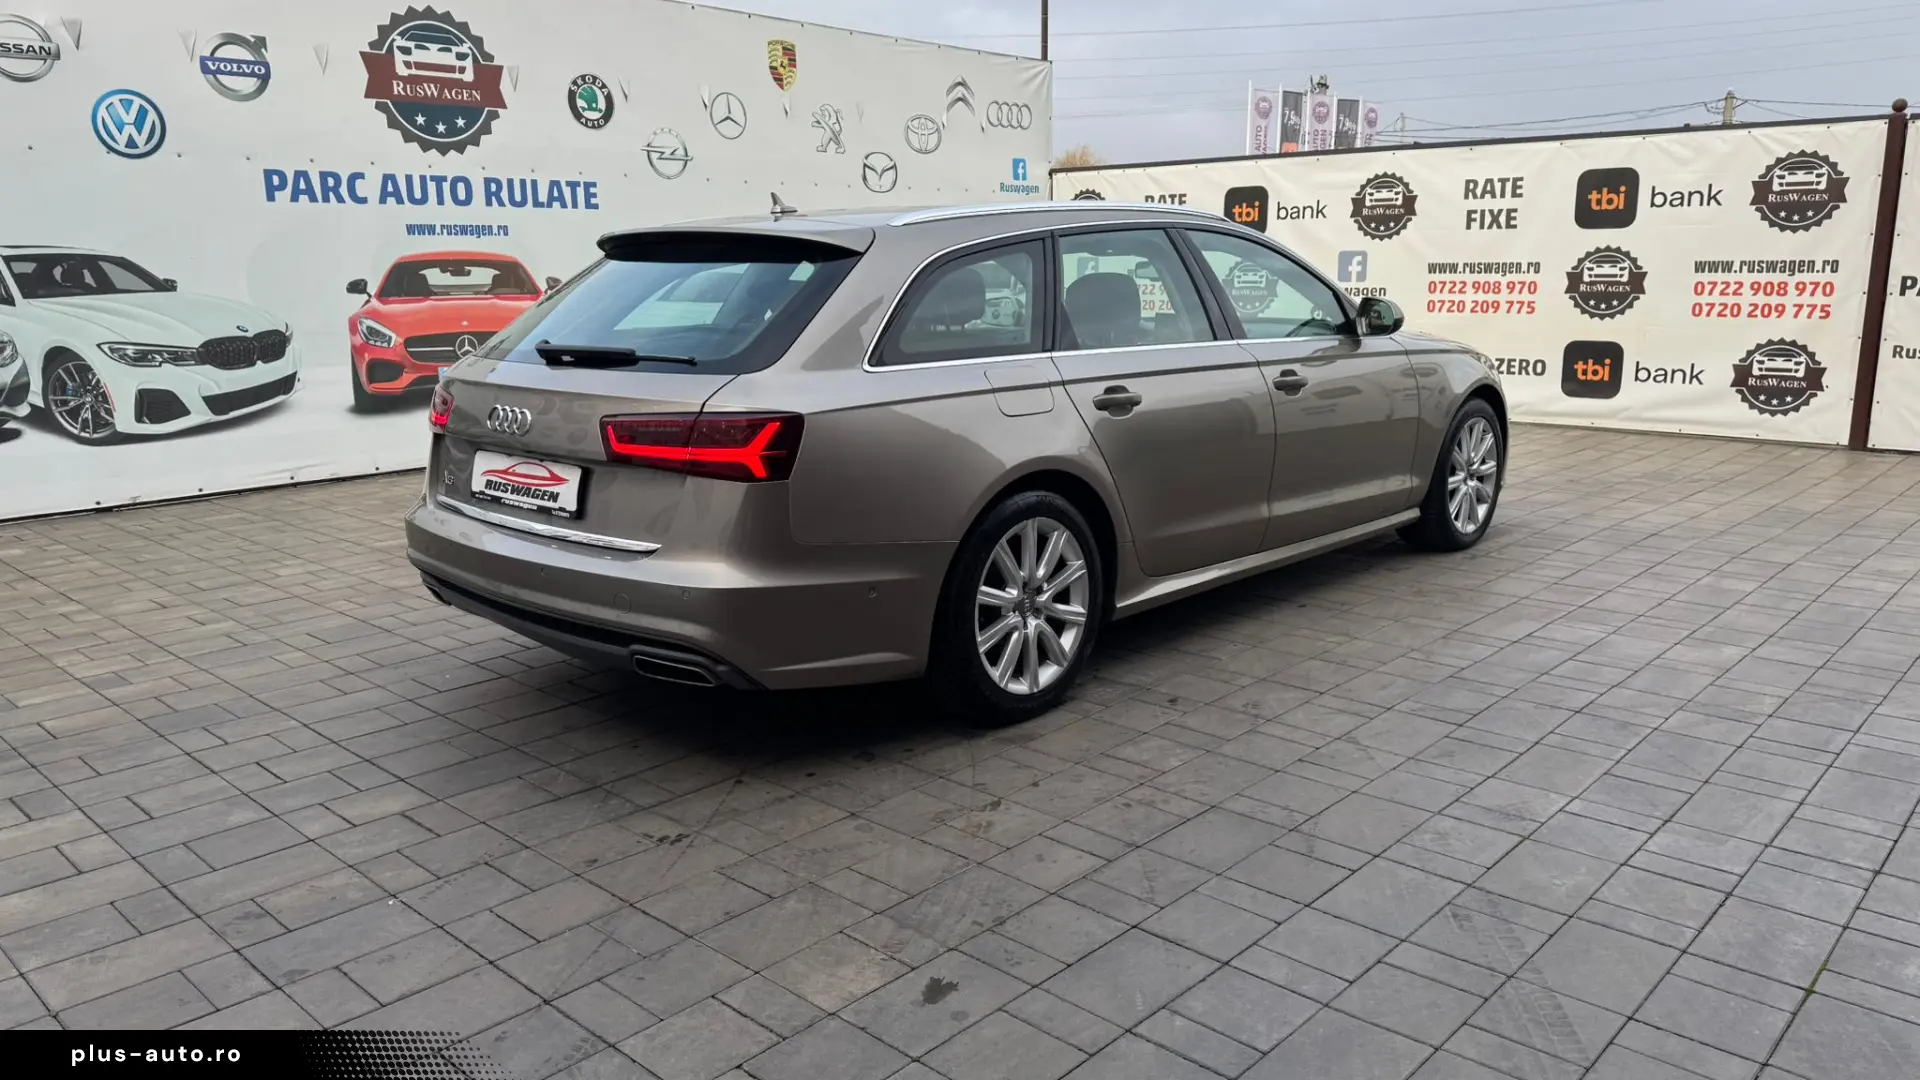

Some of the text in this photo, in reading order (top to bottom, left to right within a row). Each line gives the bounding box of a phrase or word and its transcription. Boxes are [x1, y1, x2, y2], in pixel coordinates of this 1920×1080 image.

[205, 61, 265, 74] VOLVO
[580, 117, 605, 128] AUTO
[263, 169, 599, 210] PARC AUTO RULATE
[1000, 182, 1040, 195] Ruswagen
[1464, 176, 1524, 200] RATE
[1588, 183, 1723, 211] tbi bank
[1232, 200, 1328, 222] tbi bank
[1466, 208, 1518, 230] FIXE
[405, 223, 509, 238] www.ruswagen.ro
[1427, 261, 1541, 277] www.ruswagen.ro
[1694, 259, 1840, 277] www.ruswagen.ro
[1428, 281, 1538, 295] 0722 908 970
[1693, 281, 1835, 298] 0722 908 970
[1426, 300, 1536, 314] 0720 209 775
[1691, 302, 1832, 319] 0720 209 775
[1495, 358, 1547, 376] ZERO
[1574, 359, 1705, 385] tbi bank
[484, 478, 560, 503] RUSWAGEN
[501, 498, 537, 510] ruswagen
